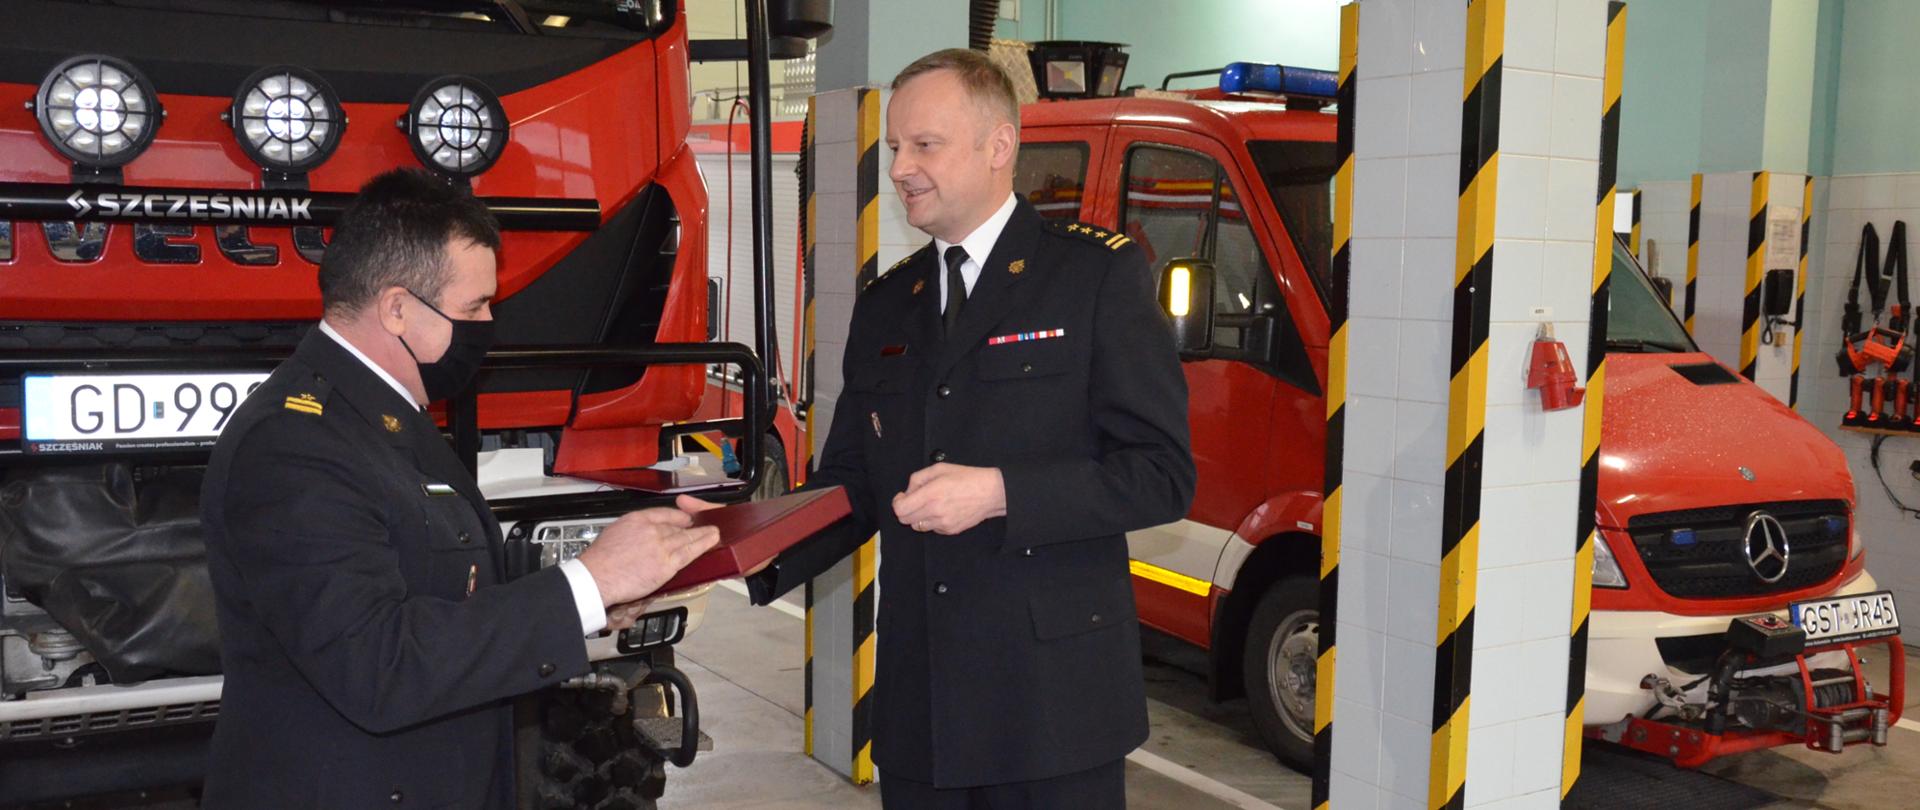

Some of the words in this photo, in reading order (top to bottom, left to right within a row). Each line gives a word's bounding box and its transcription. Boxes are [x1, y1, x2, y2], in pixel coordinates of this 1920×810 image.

[70, 383, 146, 434] GD
[173, 381, 263, 433] 99
[1803, 603, 1841, 635] GST
